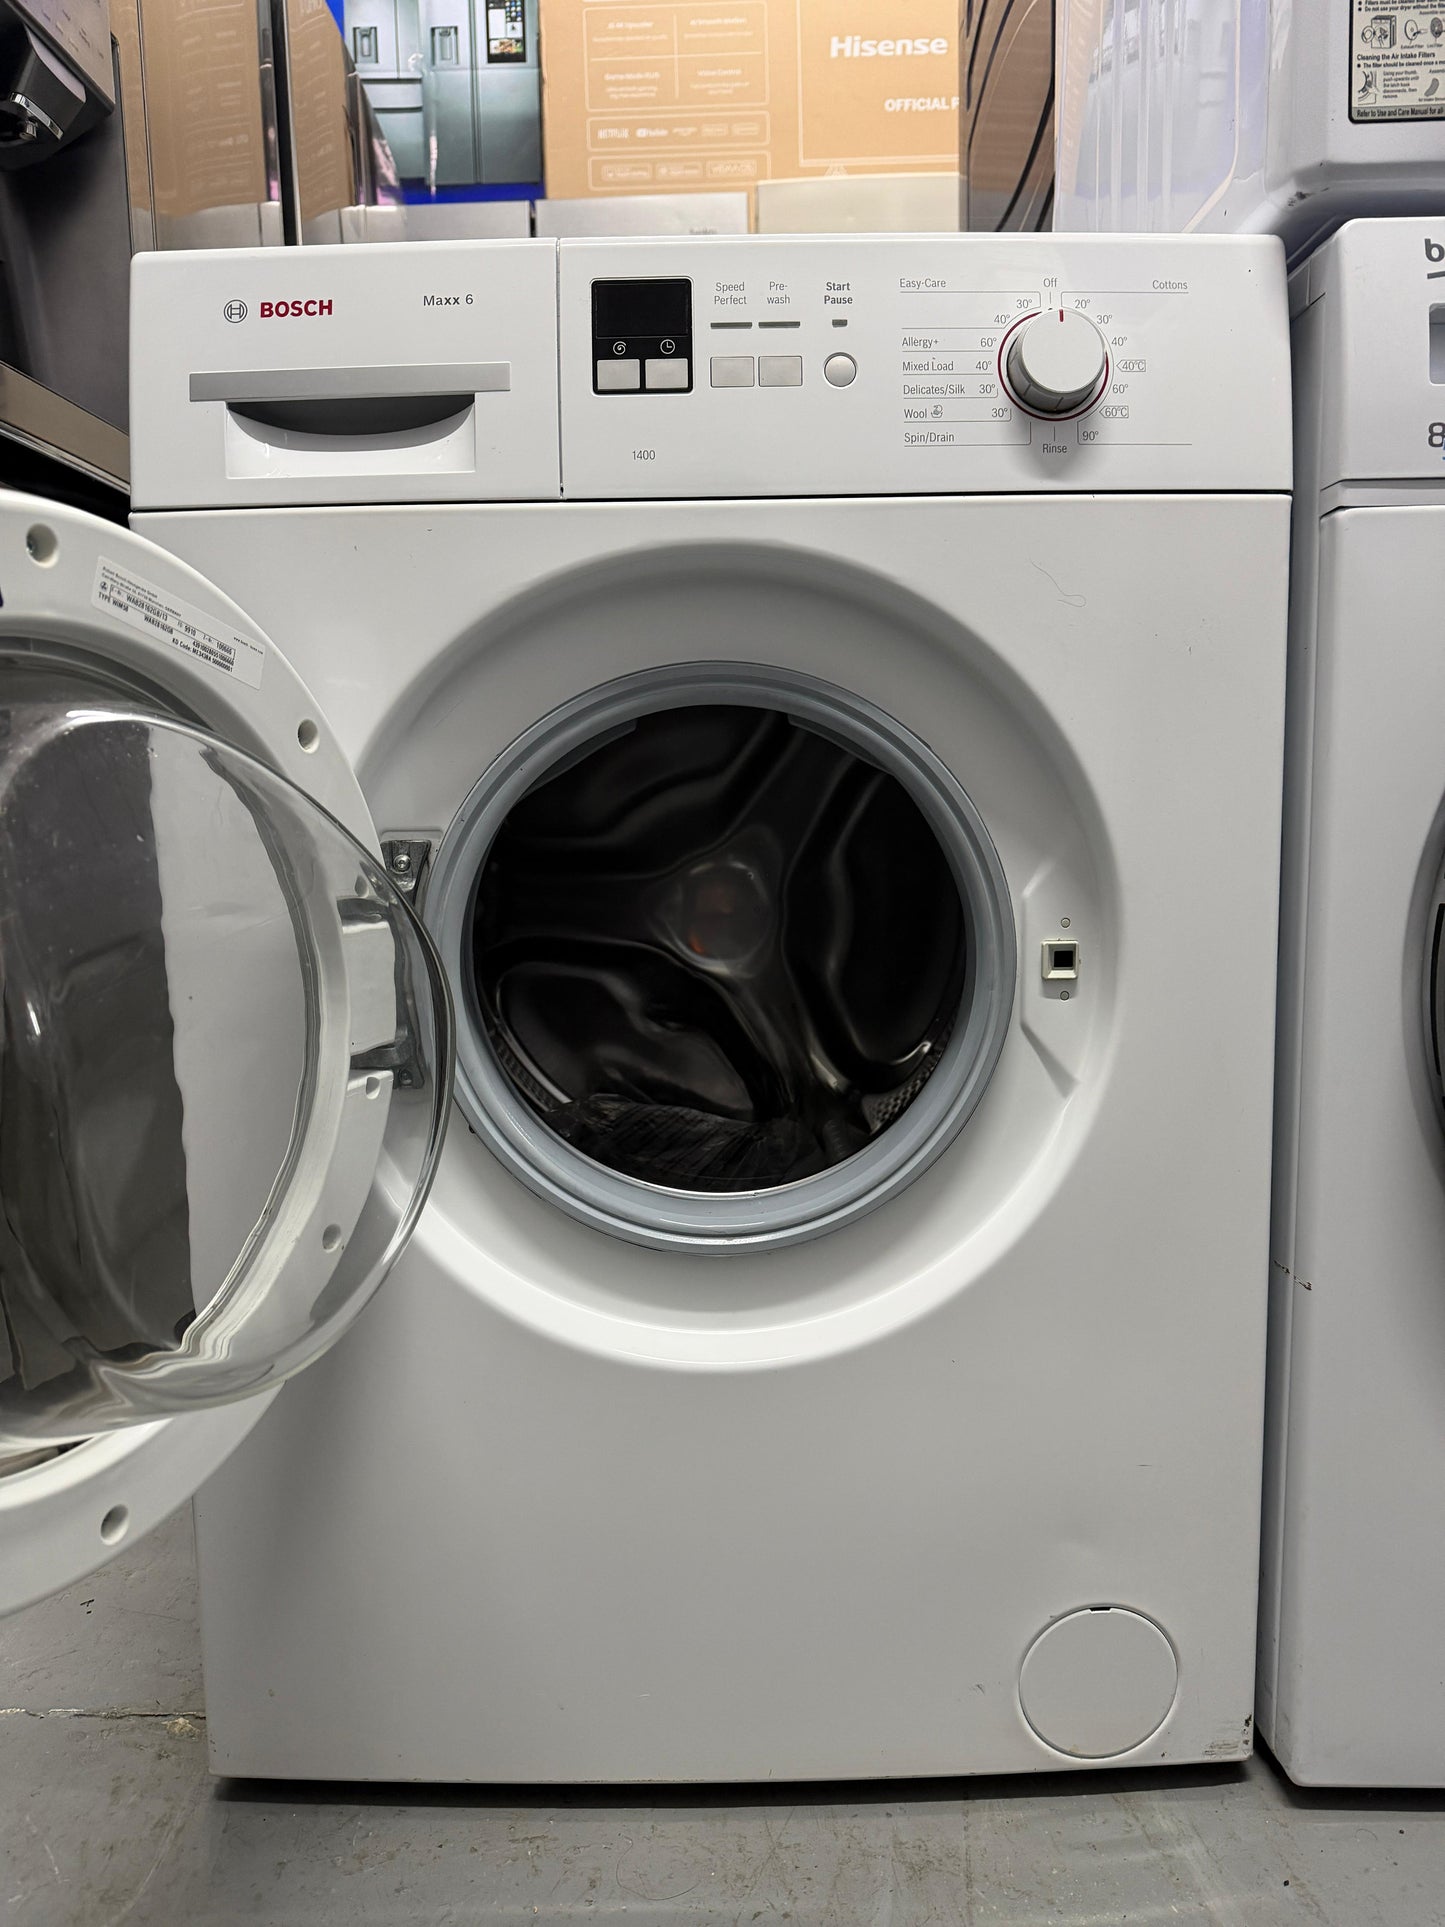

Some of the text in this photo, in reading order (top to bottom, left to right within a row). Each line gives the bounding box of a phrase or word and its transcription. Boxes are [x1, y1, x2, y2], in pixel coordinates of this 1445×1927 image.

[830, 35, 948, 58] Hisense
[884, 97, 949, 112] OFFICIAL
[716, 282, 745, 293] Speed
[769, 281, 788, 291] Pre-
[826, 282, 850, 291] Start
[900, 278, 946, 289] Easy-Care
[1043, 278, 1057, 288] Off
[1153, 280, 1188, 289] Cottons
[423, 294, 473, 306] Maxx 6
[714, 295, 747, 305] Perfect
[767, 295, 790, 304] wash
[824, 296, 853, 305] Pause
[1017, 299, 1032, 309] 30°
[1075, 299, 1090, 309] 20°
[260, 300, 333, 318] BOSCH
[994, 314, 1010, 324] 40°
[1097, 314, 1112, 325] 30°
[902, 337, 997, 349] Allergy+ 60°
[1111, 337, 1127, 347] 40°
[902, 361, 992, 371] Mixed Load 40°
[1122, 361, 1145, 371] 40°C
[903, 384, 995, 395] Delicates/Silk 30°
[1113, 384, 1128, 394] 60°
[904, 408, 1008, 419] Wool 30°
[1105, 407, 1128, 418] 60°C
[904, 432, 954, 444] Spin/Drain
[1082, 431, 1099, 441] 90°
[1042, 443, 1067, 454] Rinse
[632, 450, 655, 460] 1400
